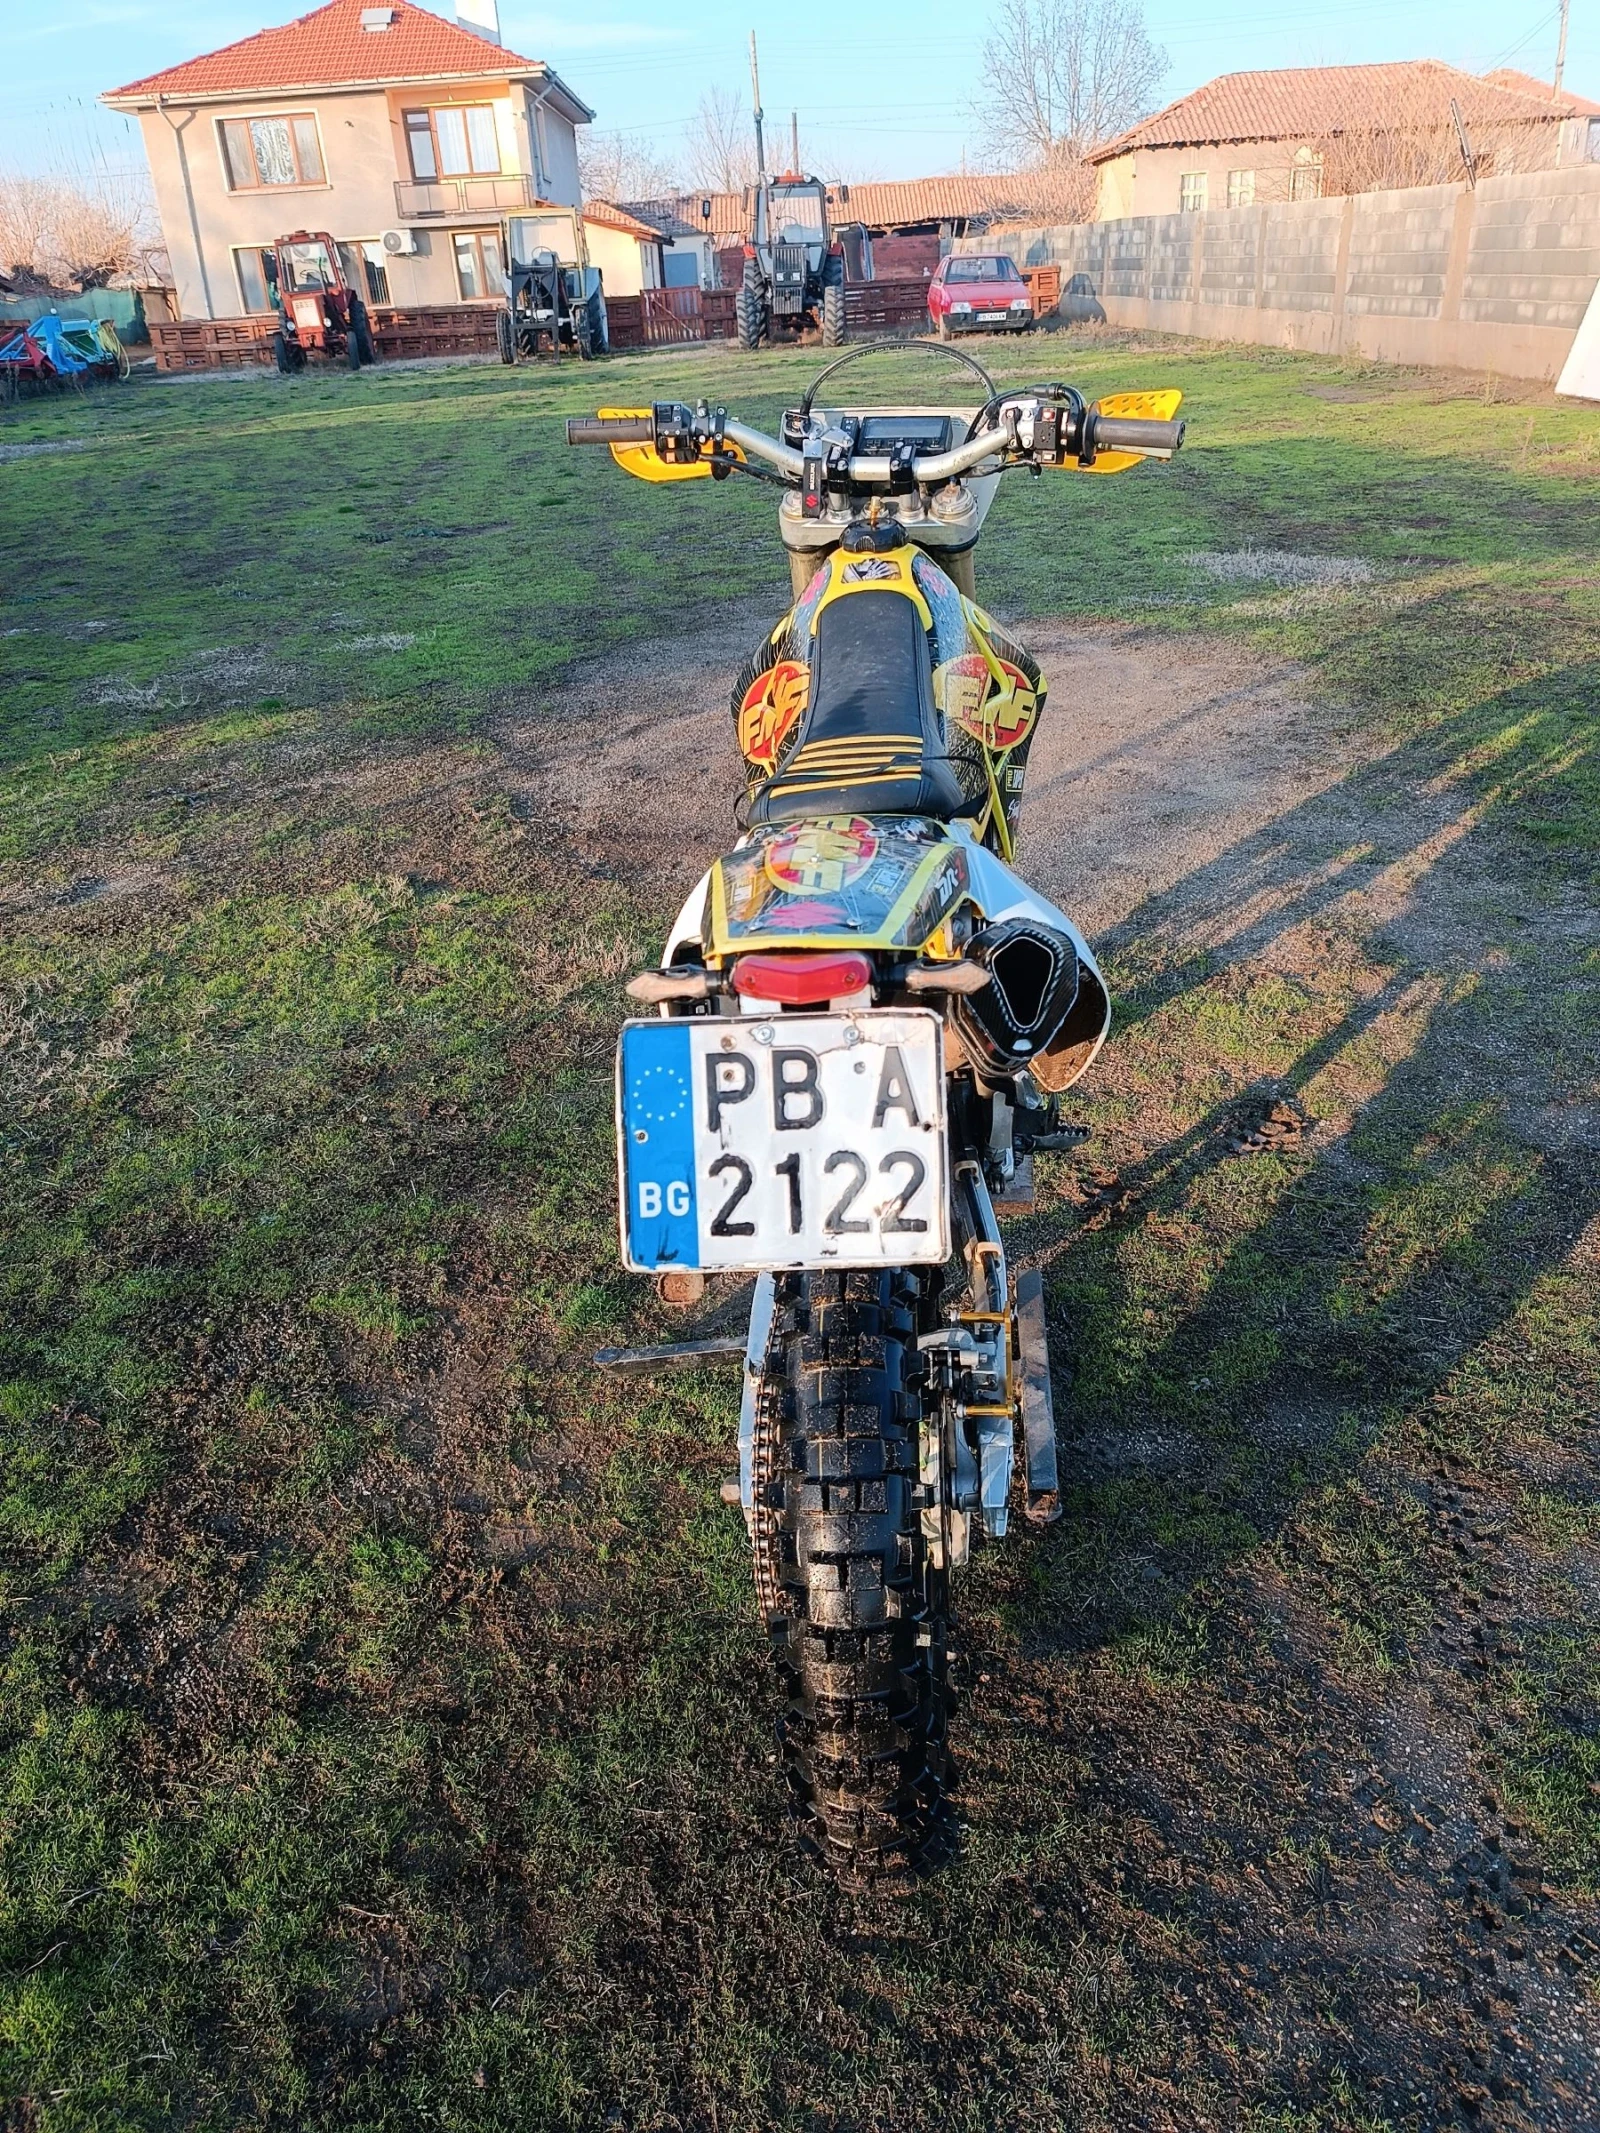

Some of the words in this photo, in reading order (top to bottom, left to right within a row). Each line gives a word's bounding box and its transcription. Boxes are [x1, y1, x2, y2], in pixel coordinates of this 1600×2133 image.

[705, 1049, 824, 1133] PB
[871, 1046, 922, 1129] A
[638, 1180, 690, 1219] BG
[707, 1150, 929, 1237] 2122
